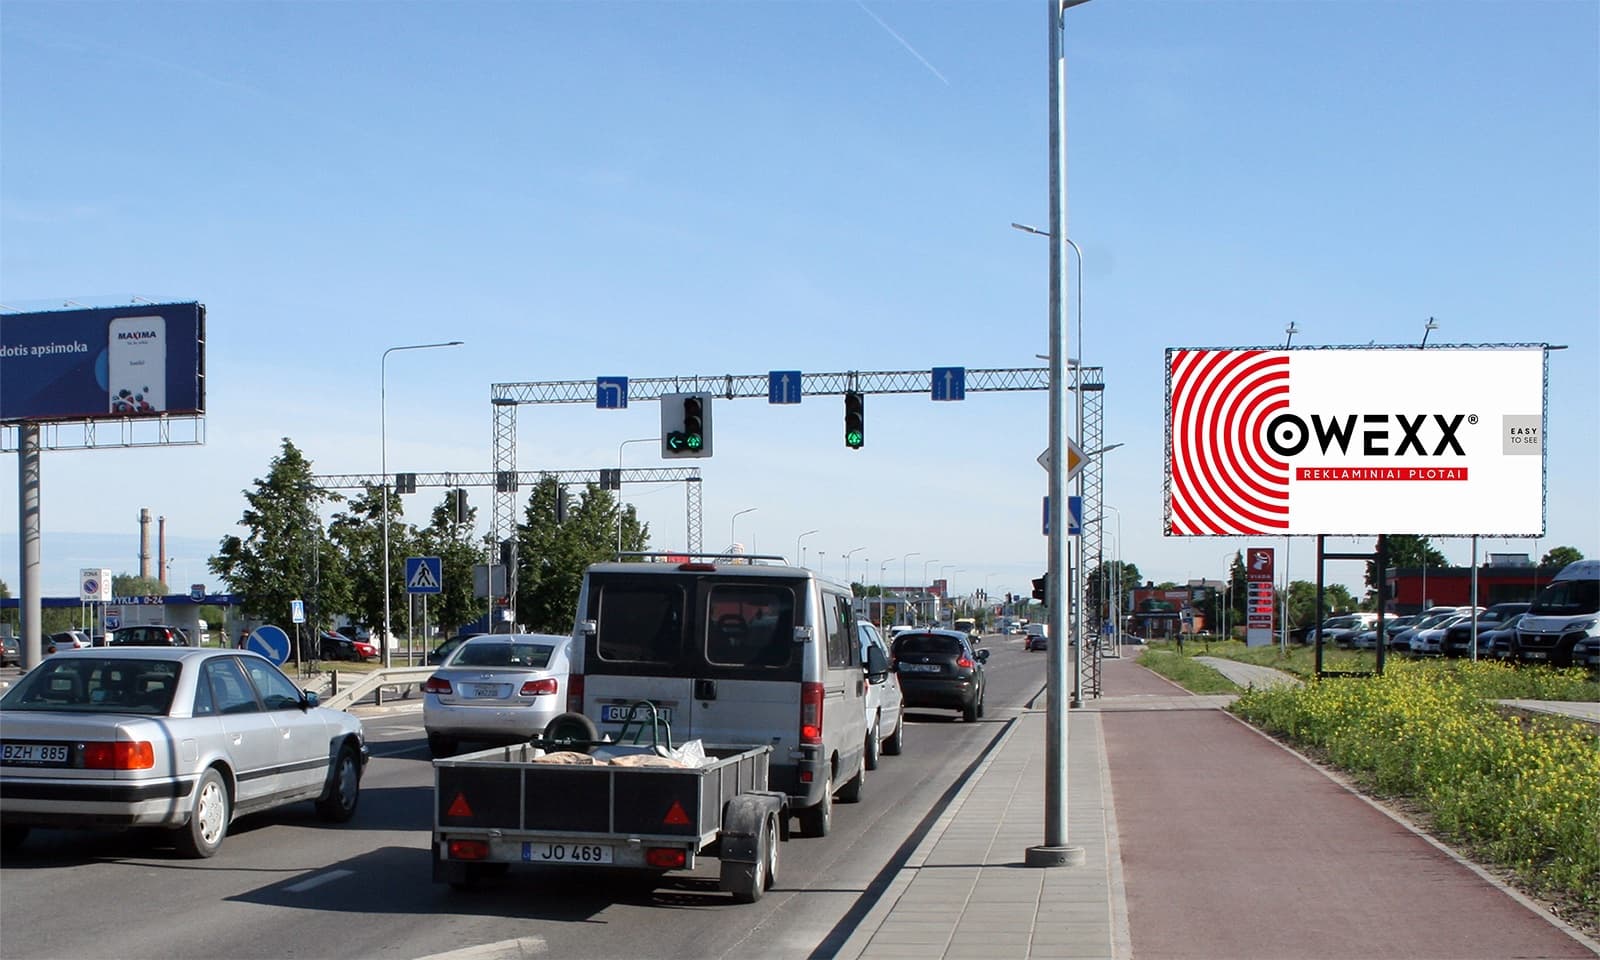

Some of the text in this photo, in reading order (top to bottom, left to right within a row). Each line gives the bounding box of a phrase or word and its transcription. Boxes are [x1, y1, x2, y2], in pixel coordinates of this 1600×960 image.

[118, 331, 157, 340] MAXIMA
[0, 340, 88, 358] dotis apsimoka
[1510, 427, 1537, 435] EASY
[1511, 436, 1538, 444] TO SEE
[1303, 469, 1461, 479] REKLAMINIAI PLOTAI
[4, 745, 66, 760] BZH 885
[541, 844, 602, 861] JO 469
